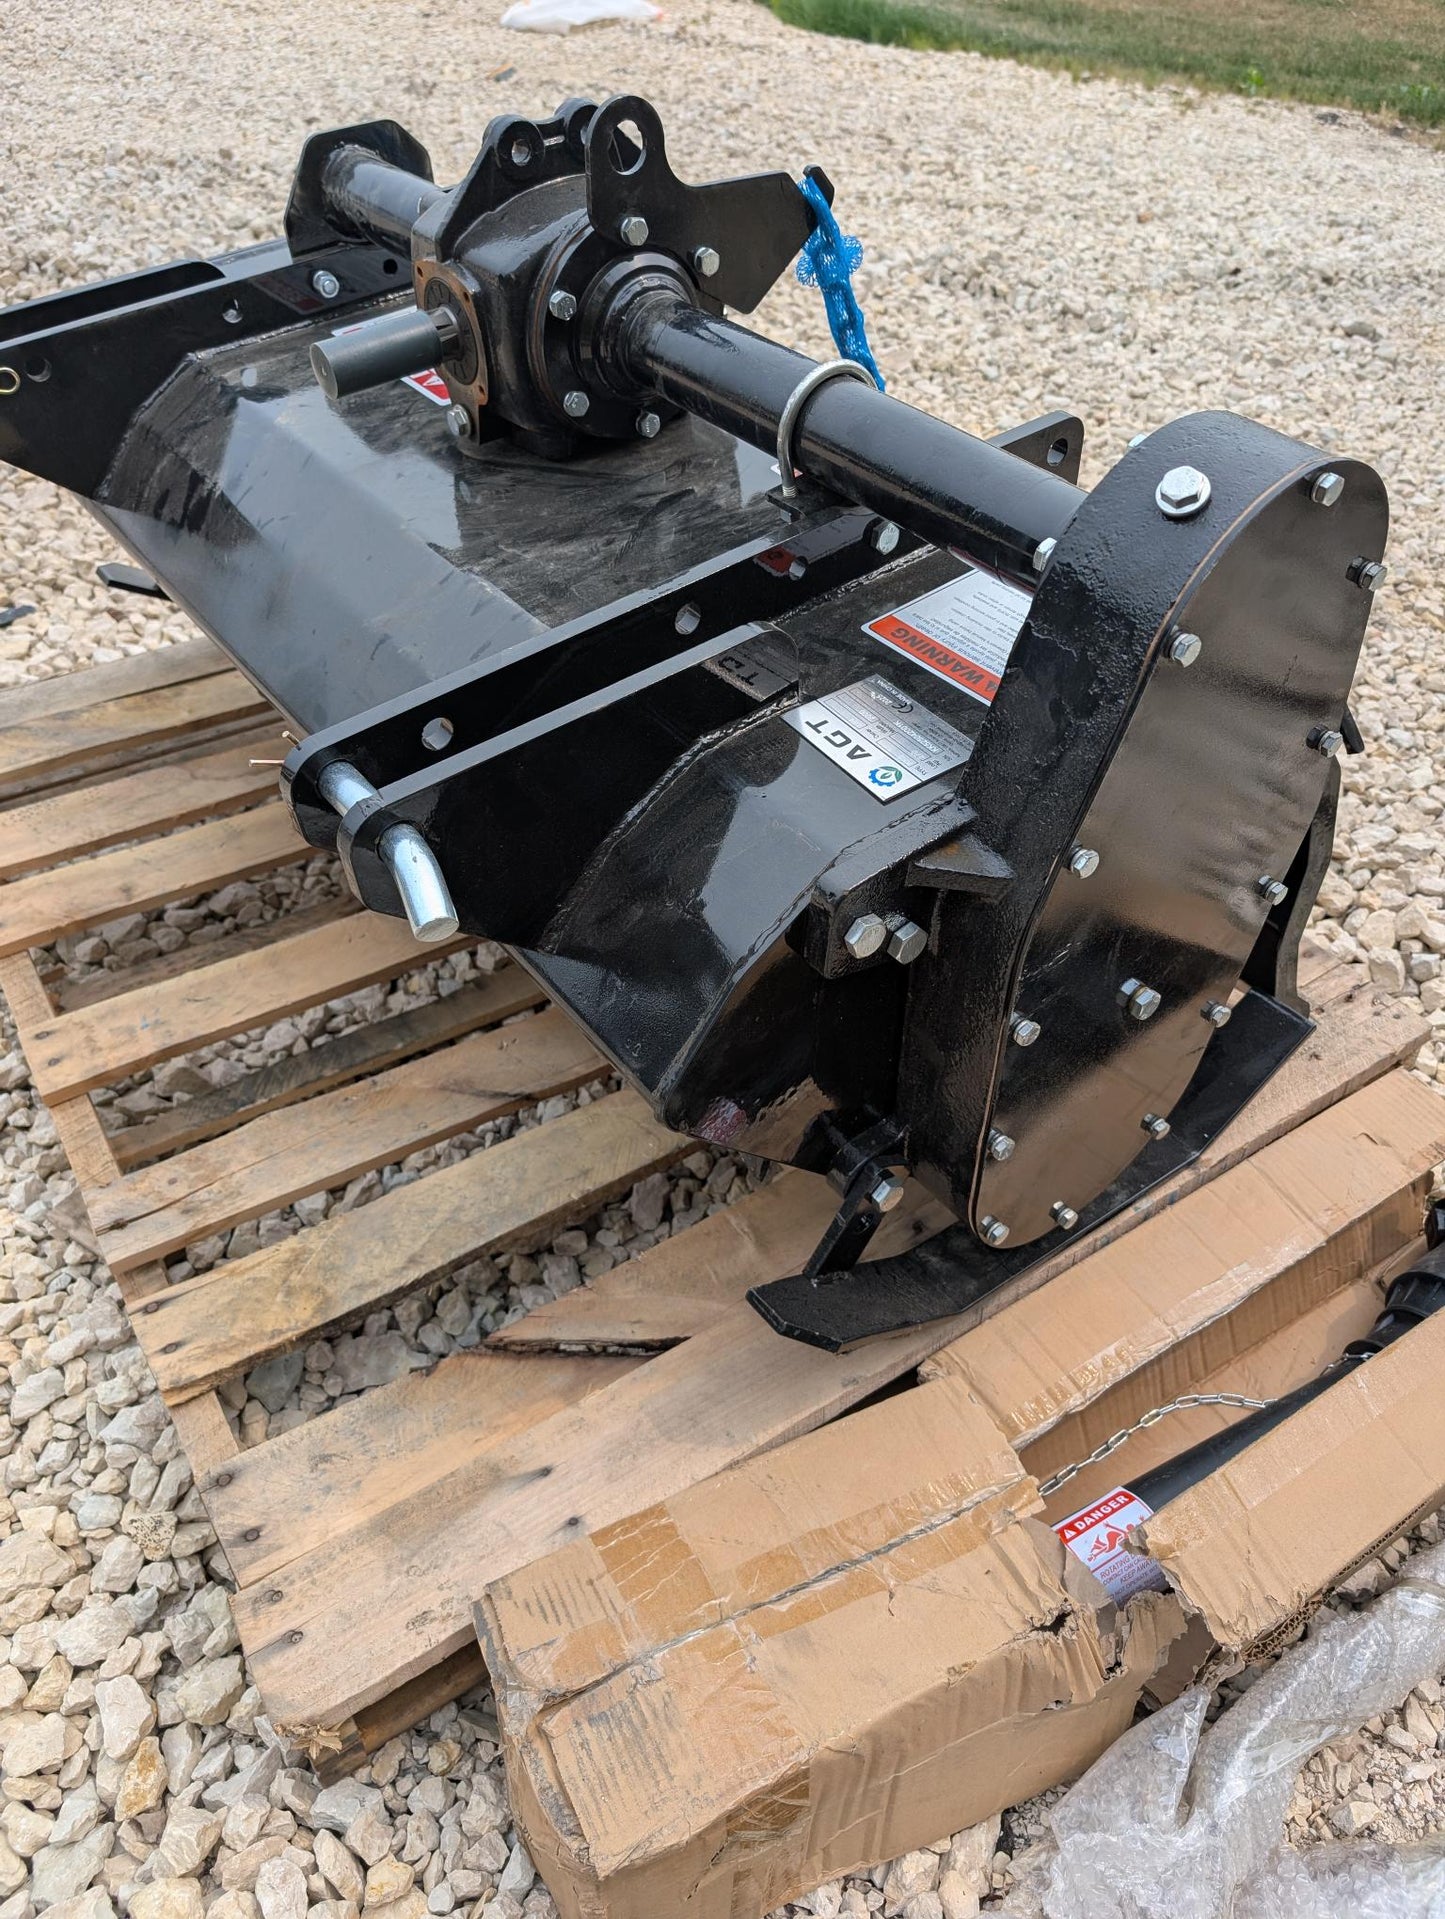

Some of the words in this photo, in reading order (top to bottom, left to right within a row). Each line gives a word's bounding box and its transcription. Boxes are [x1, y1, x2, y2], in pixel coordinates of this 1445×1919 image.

[890, 627, 984, 684] WARNING
[804, 719, 872, 760] AGT
[1074, 1495, 1129, 1530] DANGER
[1100, 1554, 1130, 1579] ROTATING
[1102, 1568, 1125, 1586] CONTACT
[1123, 1561, 1134, 1572] CAN
[1119, 1569, 1137, 1584] KEEP
